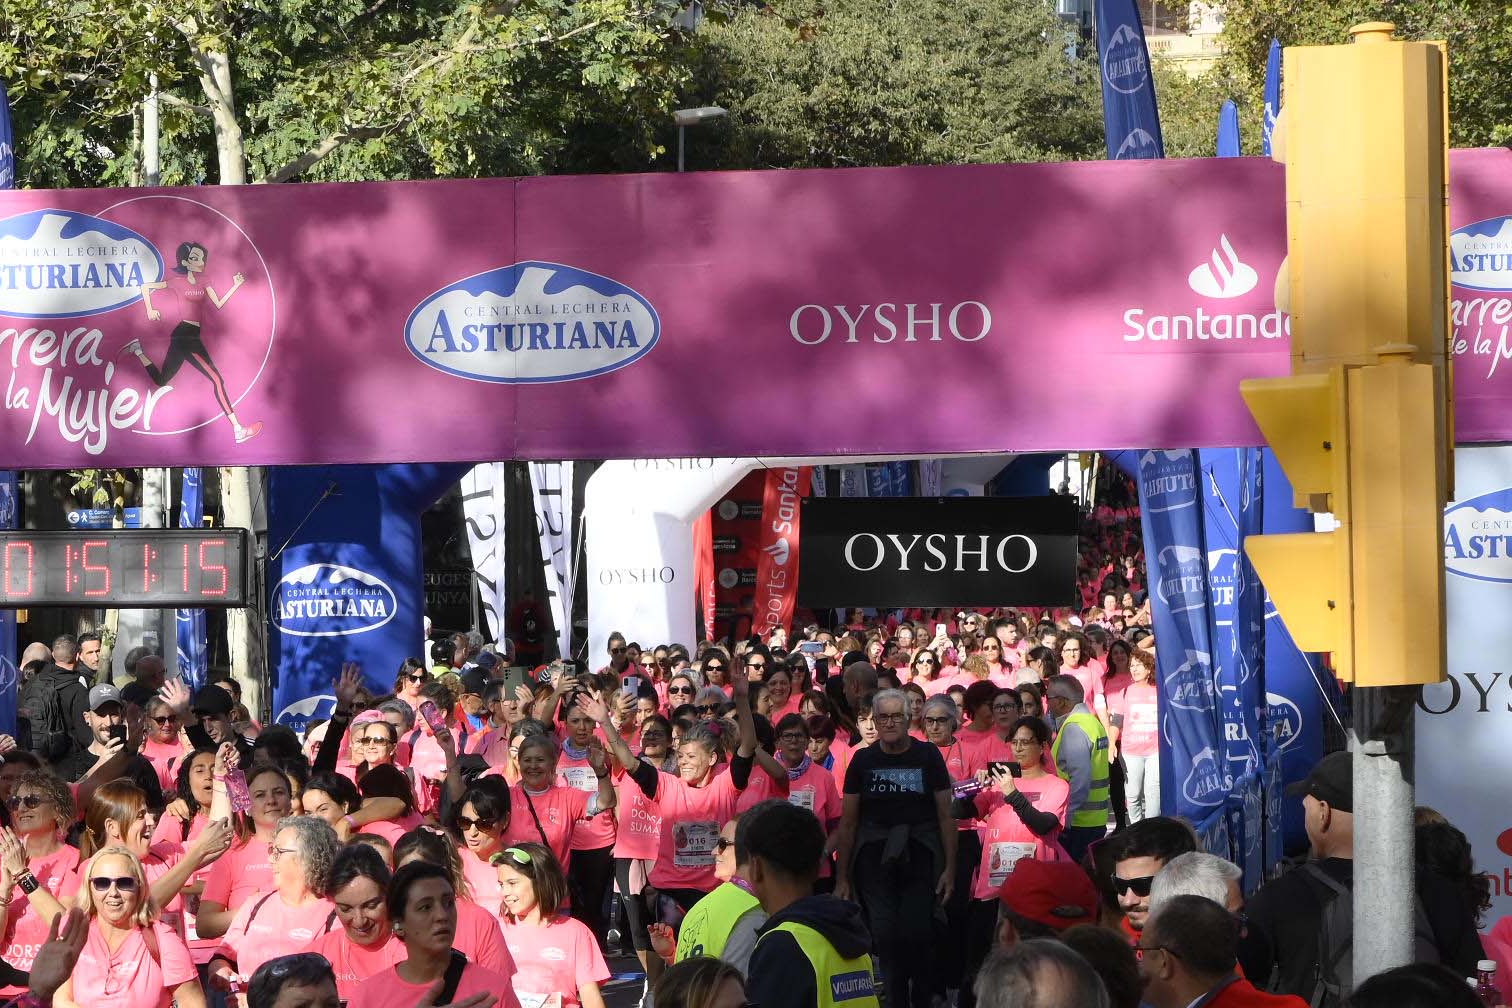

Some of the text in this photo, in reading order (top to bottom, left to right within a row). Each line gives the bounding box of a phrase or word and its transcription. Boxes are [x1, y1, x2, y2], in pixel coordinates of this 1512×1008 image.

[67, 245, 138, 257] LECHERA
[464, 302, 632, 316] CENTRAL LECHERA
[790, 301, 992, 344] OYSHO
[424, 309, 640, 352] ASTURIANA
[1123, 307, 1291, 341] Santand
[1474, 327, 1492, 355] la
[5, 368, 30, 410] la
[25, 360, 174, 455] Mujer
[844, 532, 1038, 573] OYSHO
[4, 541, 227, 596] 01:51:15
[599, 566, 675, 585] OYSHO
[275, 592, 388, 620] ASTURIANA
[287, 587, 383, 598] CENTRAL LECHERA
[870, 783, 917, 793] JONES
[871, 771, 915, 781] JACKS
